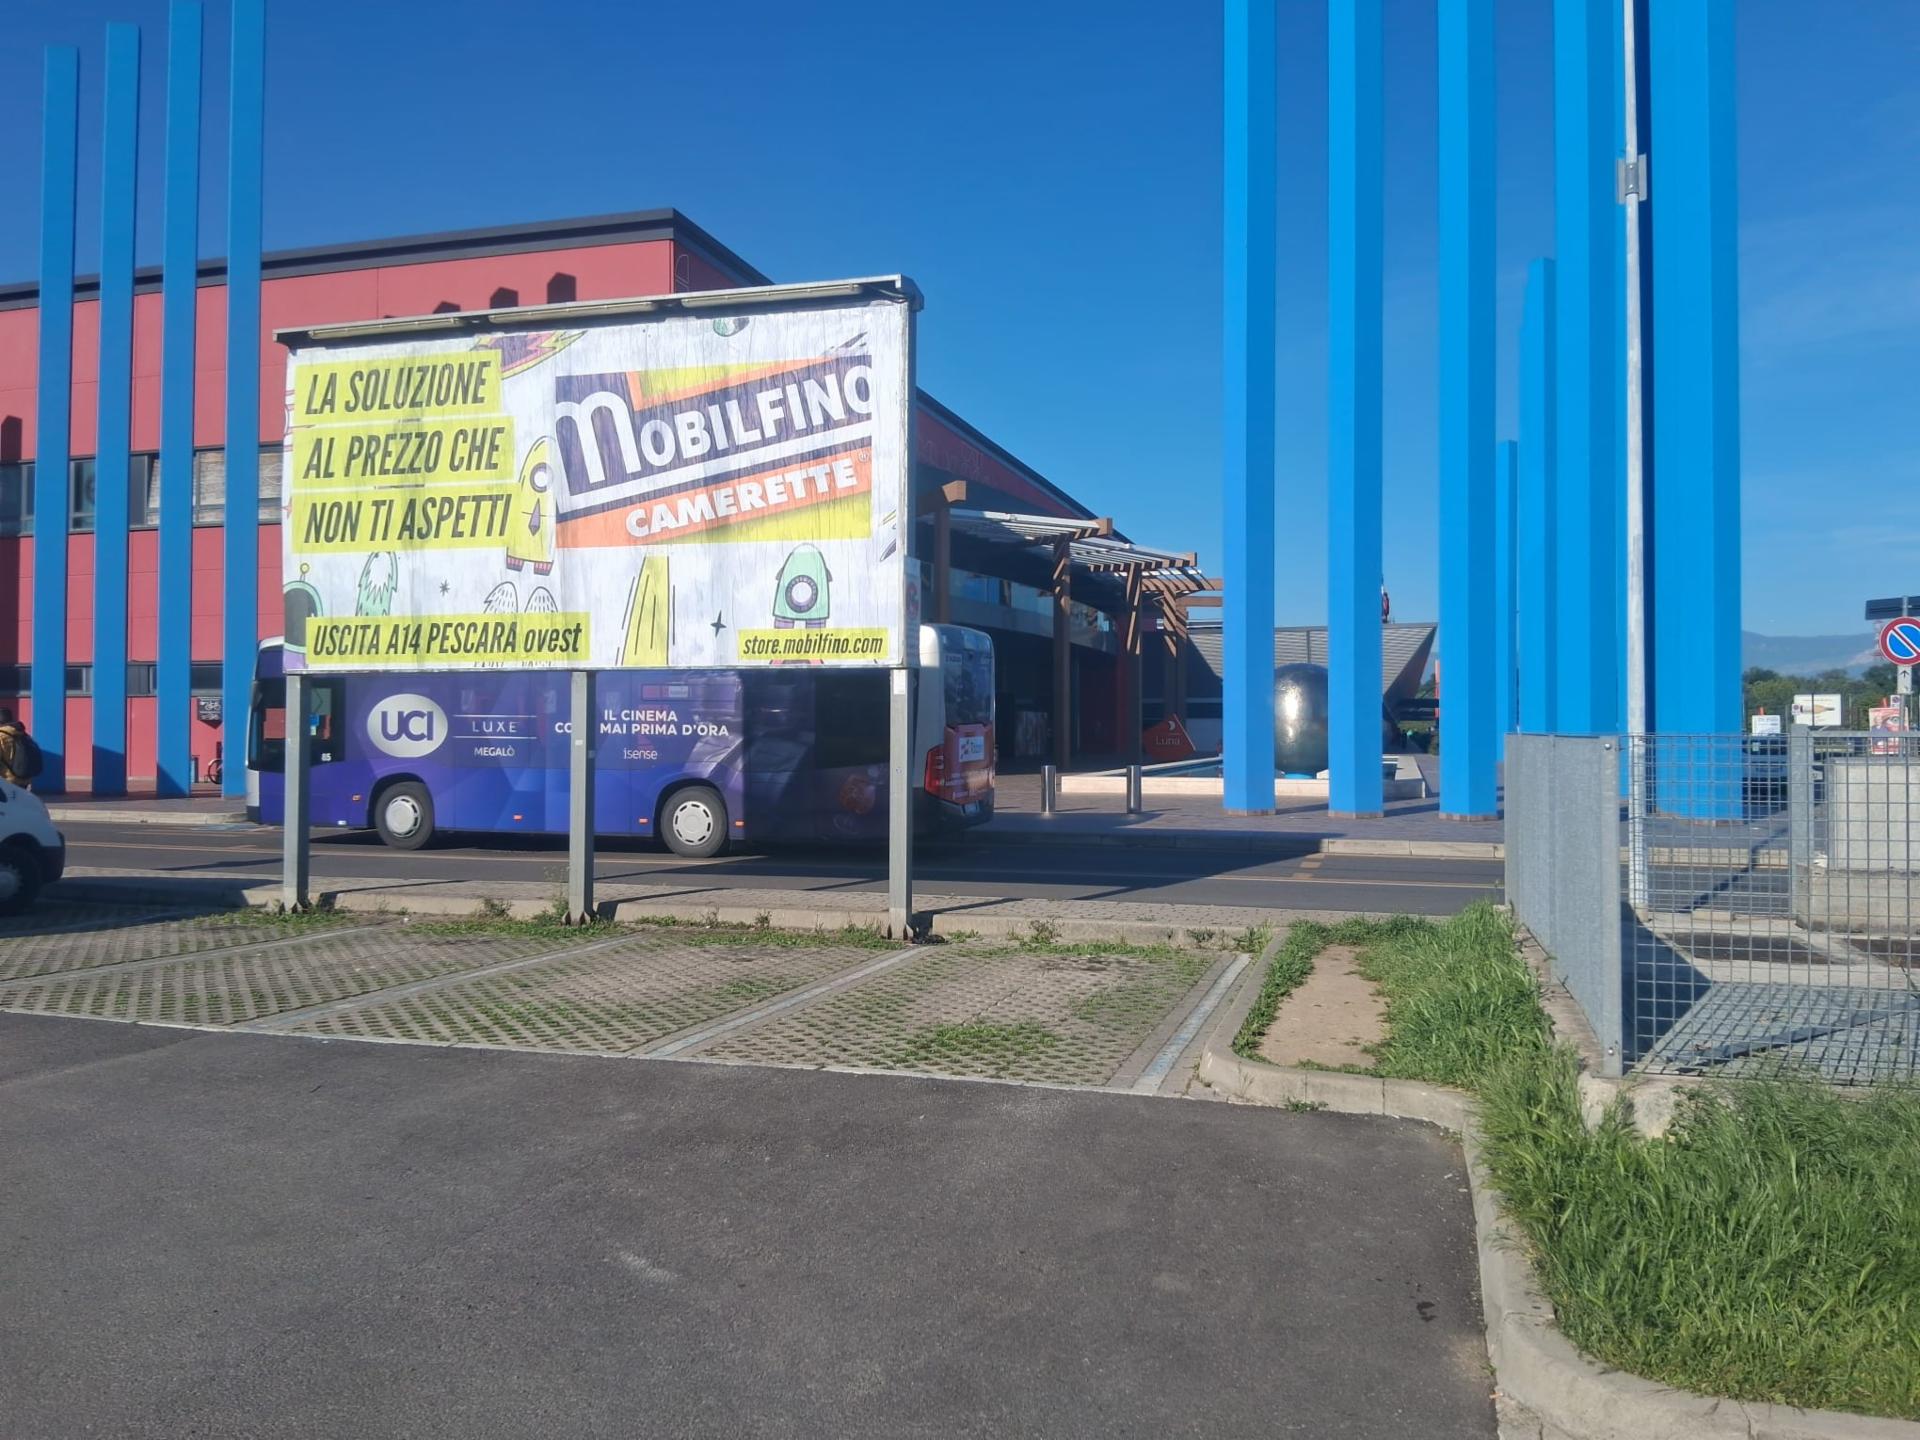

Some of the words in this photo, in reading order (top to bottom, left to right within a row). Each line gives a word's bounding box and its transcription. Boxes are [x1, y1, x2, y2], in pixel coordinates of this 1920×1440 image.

[305, 372, 337, 414] LA
[344, 361, 491, 413] SOLUZIONE
[302, 437, 335, 479] AL
[344, 430, 443, 477] PREZZO
[449, 427, 505, 472] CHE
[625, 458, 858, 538] CAMERETTE
[304, 501, 363, 543] NON
[369, 499, 394, 541] TI
[397, 493, 512, 540] ASPETTI
[313, 624, 380, 656] USCITA
[385, 623, 422, 655] A14
[426, 621, 517, 654] PESCARA
[523, 623, 582, 653] ovest
[743, 633, 883, 654] store.mobilfino.com
[381, 710, 434, 742] UCI
[472, 721, 517, 733] LUXE
[600, 722, 626, 734] MAI
[631, 723, 677, 736] PRIMA
[682, 724, 729, 737] D'ORA
[604, 710, 616, 721] IL
[620, 709, 678, 722] CINEMA
[474, 744, 515, 757] MEGALÒ
